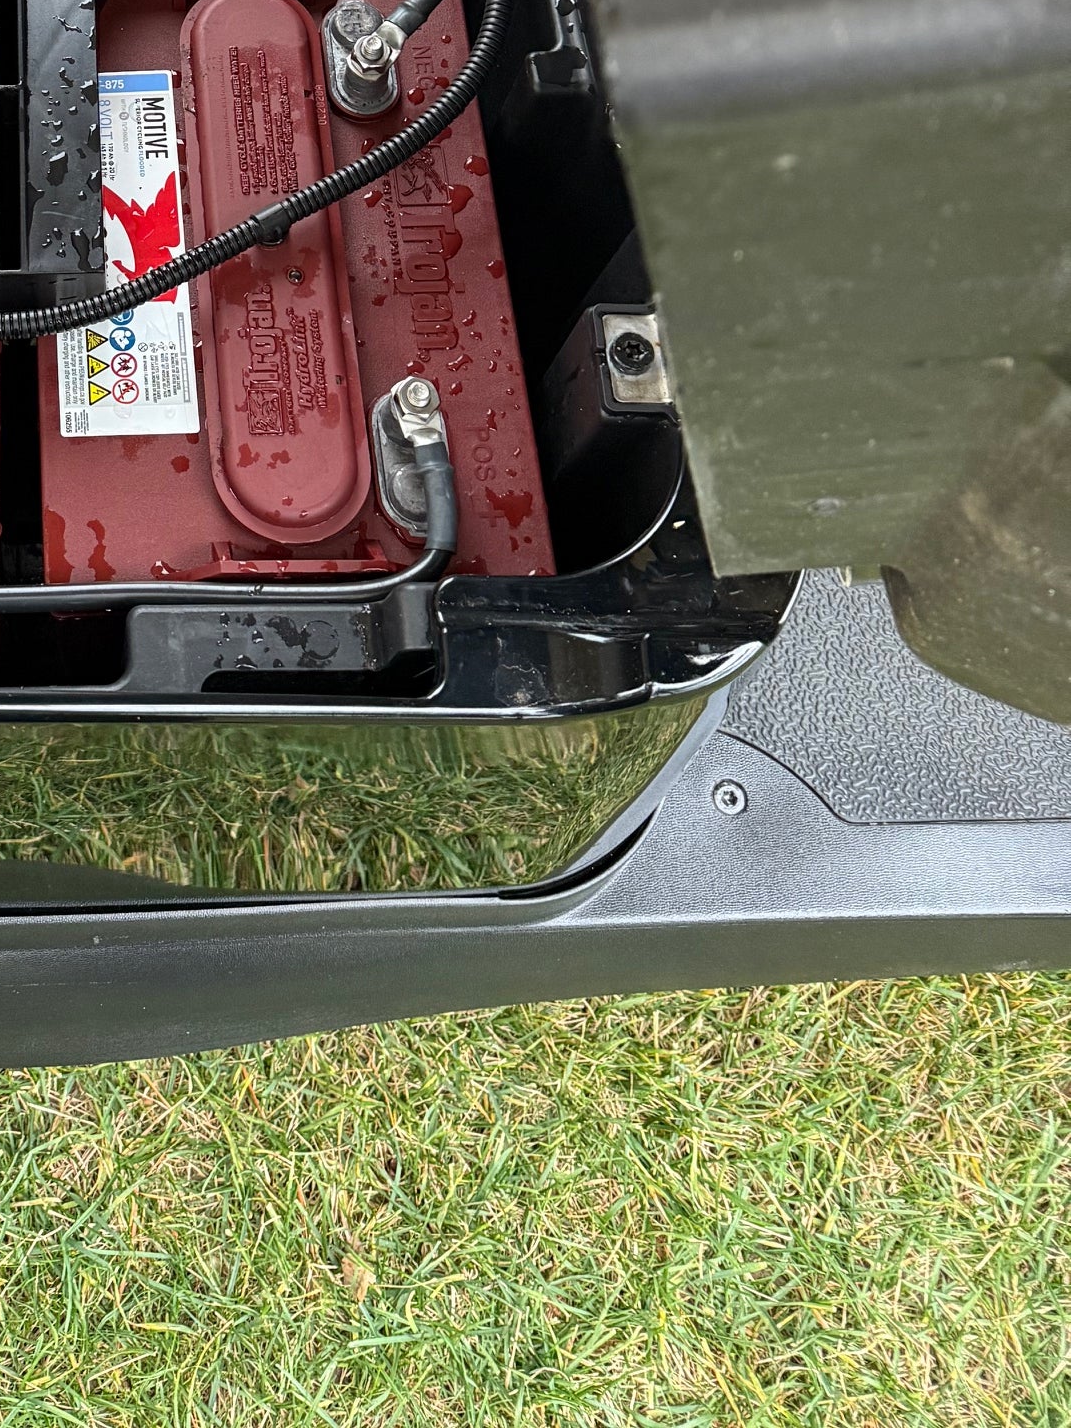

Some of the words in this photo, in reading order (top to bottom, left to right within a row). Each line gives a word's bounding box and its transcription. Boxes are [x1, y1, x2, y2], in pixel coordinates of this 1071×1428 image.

[411, 45, 435, 91] NEG
[100, 109, 113, 140] VOLT
[142, 97, 168, 159] MOTIVE
[392, 208, 467, 351] Trojan
[237, 292, 284, 387] Trojan
[310, 309, 322, 351] System
[291, 315, 314, 409] HydroLink
[313, 353, 328, 408] Watering
[469, 427, 494, 482] POS
